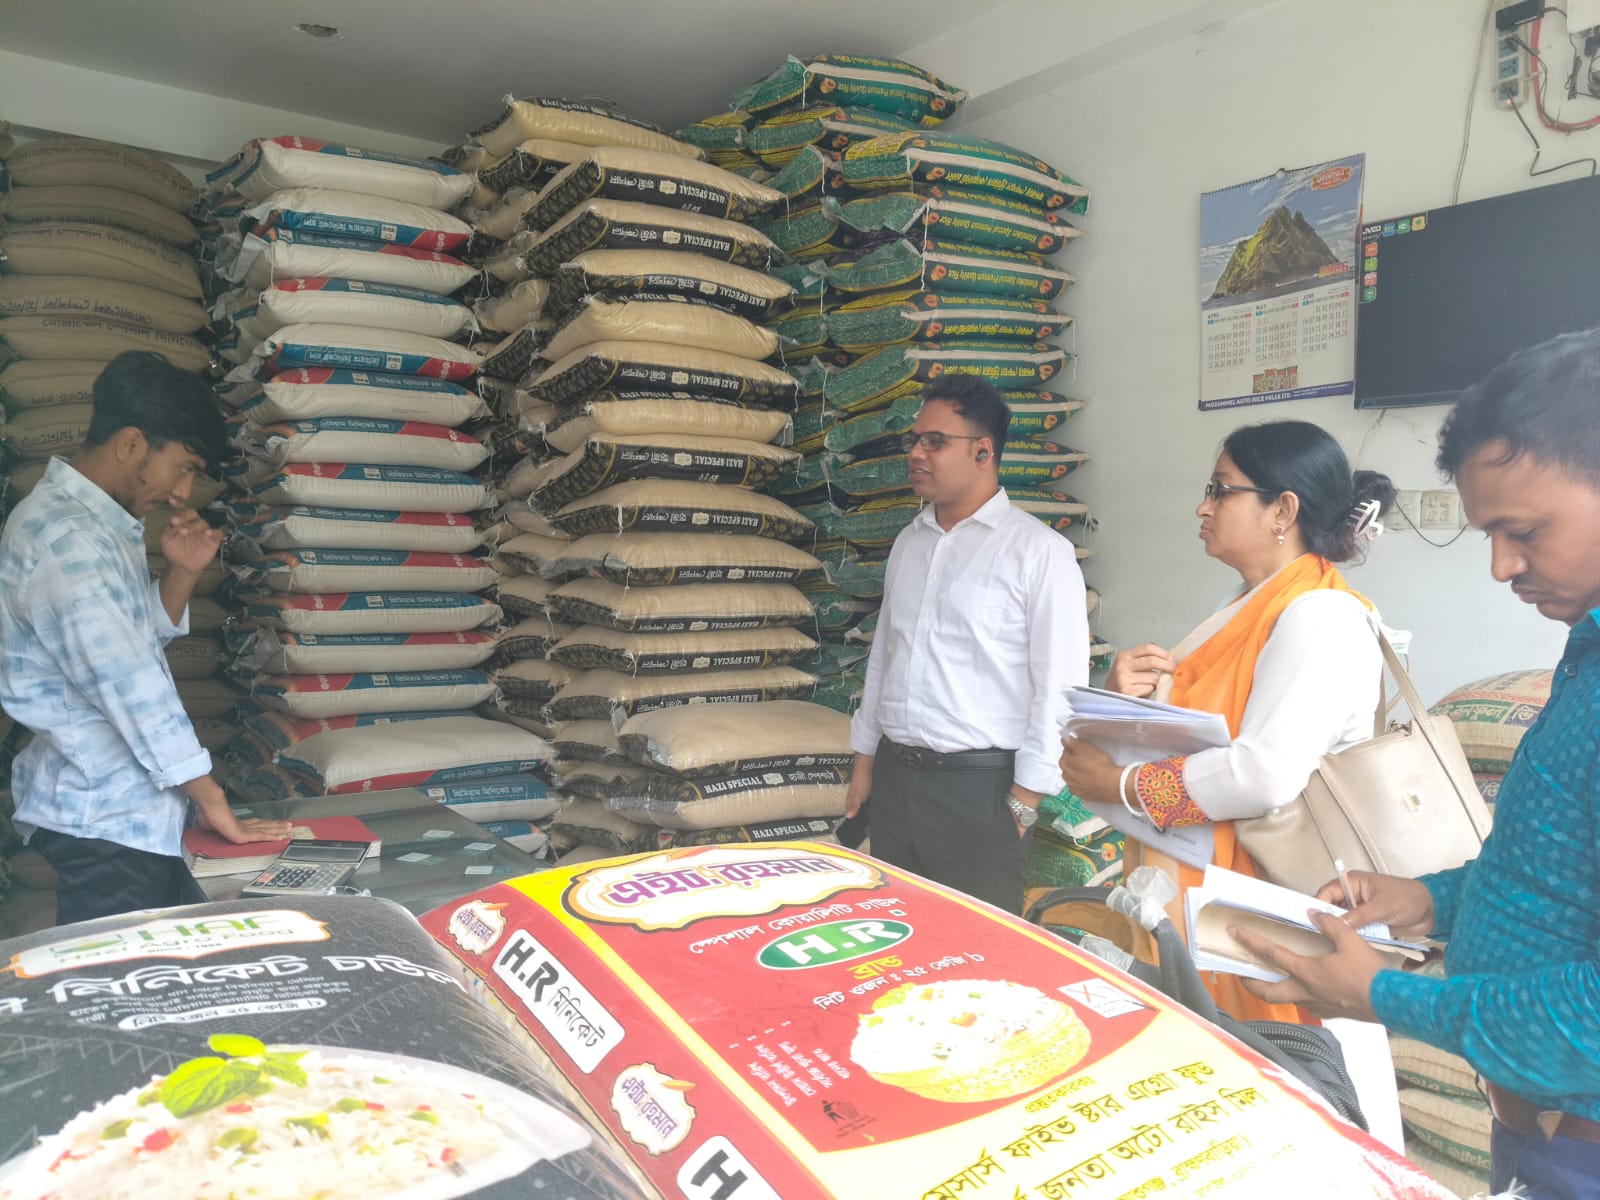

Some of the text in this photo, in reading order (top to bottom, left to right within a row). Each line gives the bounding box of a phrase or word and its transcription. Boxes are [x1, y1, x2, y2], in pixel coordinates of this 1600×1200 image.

[679, 184, 725, 204] HAZI SPECIAL
[683, 233, 730, 251] HAZI SPECIAL
[719, 286, 749, 303] SPECIAL
[748, 293, 767, 307] HAZI
[691, 374, 740, 390] HAZI SPECIAL
[1251, 395, 1265, 405] RICE
[695, 455, 744, 468] HAZI SPECIAL
[712, 514, 759, 527] HAZI SPECIAL
[747, 569, 793, 580] HAZI SPECIAL
[711, 620, 760, 630] HAZI SPECIAL
[713, 655, 761, 666] HAZI SPECIAL
[704, 776, 762, 794] HAZI SPECIAL
[752, 824, 808, 839] HAZI SPECIAL
[707, 858, 844, 887] রহমান
[689, 896, 906, 954] স্পেশাল কোয়ালিটি চাউল
[776, 920, 904, 965] H.R
[500, 936, 559, 1002] H.R
[46, 955, 310, 1003] মিনিকেট
[322, 954, 470, 994] চাউল
[812, 990, 847, 1010] নিট
[849, 975, 889, 995] ওজন
[902, 965, 928, 978] ২৫
[929, 955, 966, 971] কেজি
[547, 985, 606, 1047] মিনিকেট
[1000, 1115, 1078, 1160] ফাইভ
[1124, 1072, 1181, 1101] এগ্রো
[1173, 1061, 1216, 1085] ফুড
[1034, 1153, 1118, 1200] জনতা
[1107, 1123, 1177, 1161] অটো
[1167, 1099, 1232, 1135] রাইস
[1218, 1086, 1270, 1117] মিল
